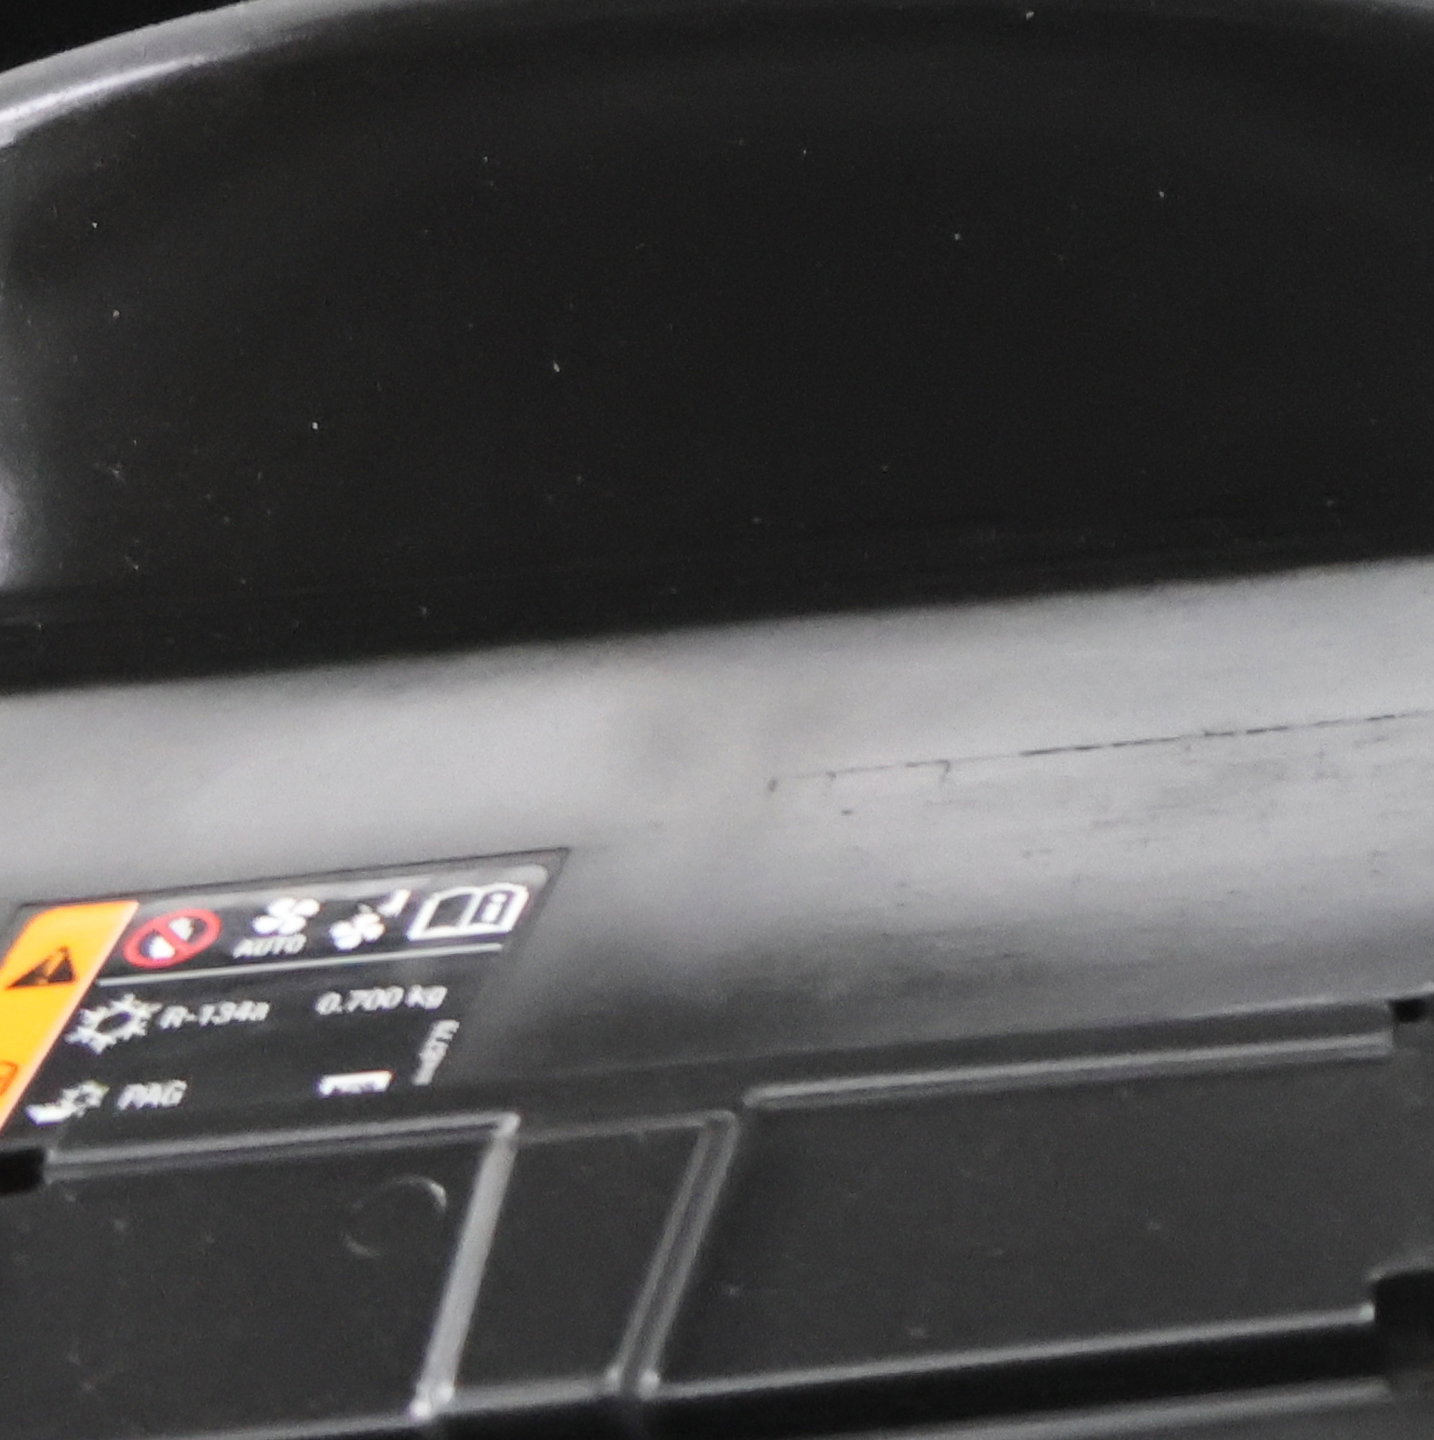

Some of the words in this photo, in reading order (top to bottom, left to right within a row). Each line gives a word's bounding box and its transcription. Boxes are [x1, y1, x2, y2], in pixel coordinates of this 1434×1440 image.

[233, 934, 307, 959] AUTO
[159, 1000, 271, 1030] R-134a
[315, 985, 403, 1015] 0.700
[405, 984, 448, 1010] kg
[117, 1079, 188, 1110] PAG
